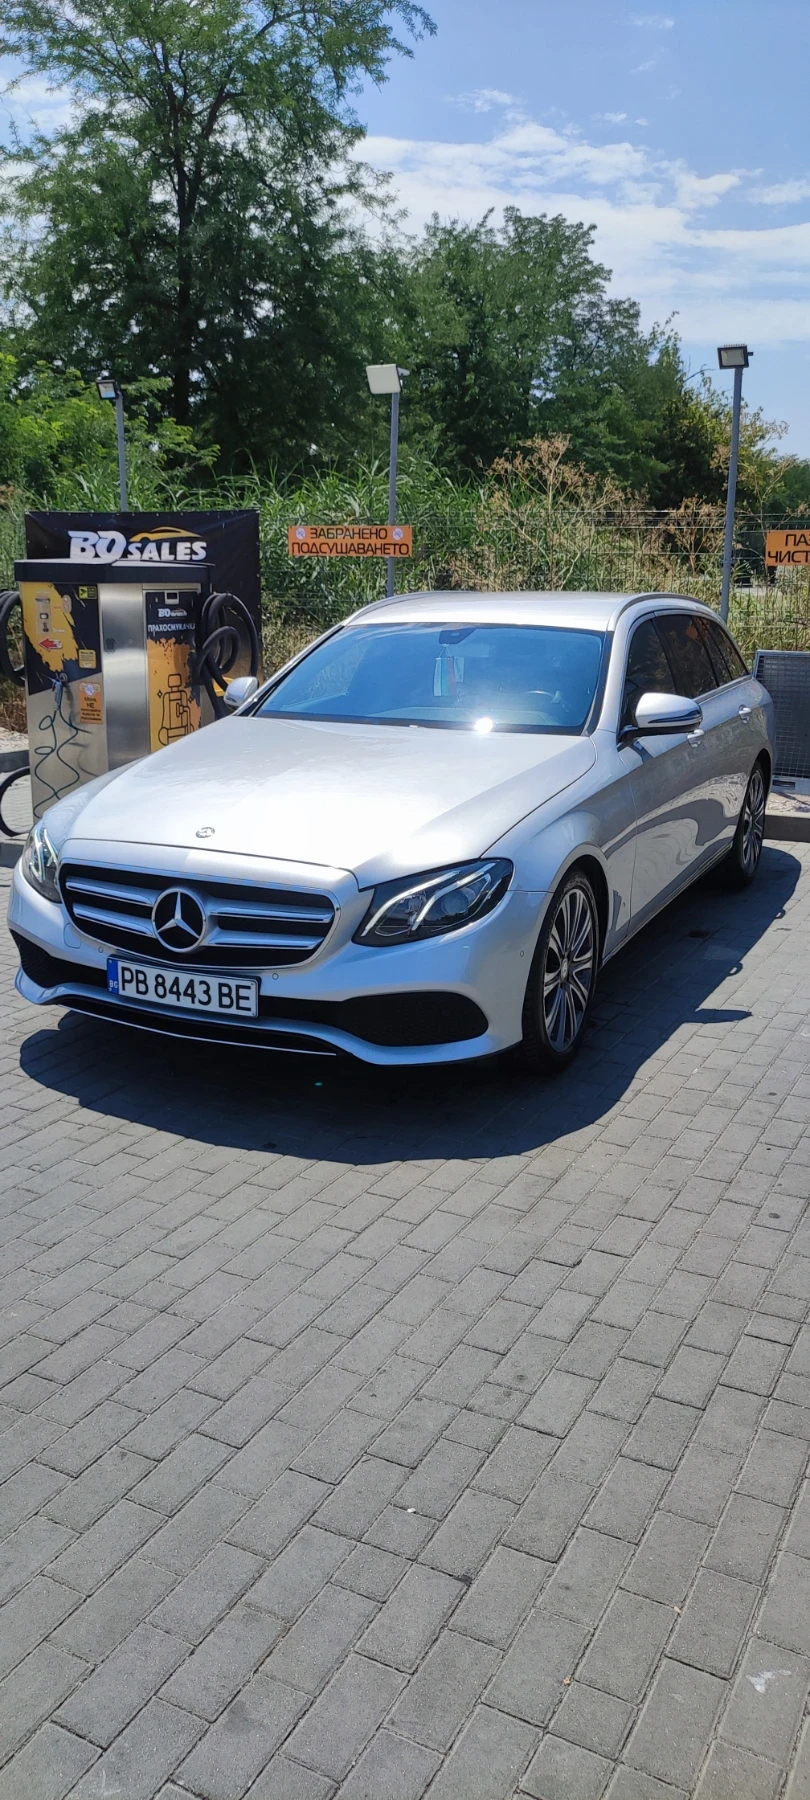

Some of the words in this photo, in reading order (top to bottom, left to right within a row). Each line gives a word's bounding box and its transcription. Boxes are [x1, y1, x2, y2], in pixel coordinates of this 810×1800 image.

[310, 527, 388, 540] ЗАБРАНЕНО
[785, 533, 810, 547] ПА
[127, 541, 207, 561] SALES
[291, 542, 410, 555] ПОДСУШАВАНЕТО
[109, 979, 119, 989] BG
[154, 973, 212, 1006] 8443
